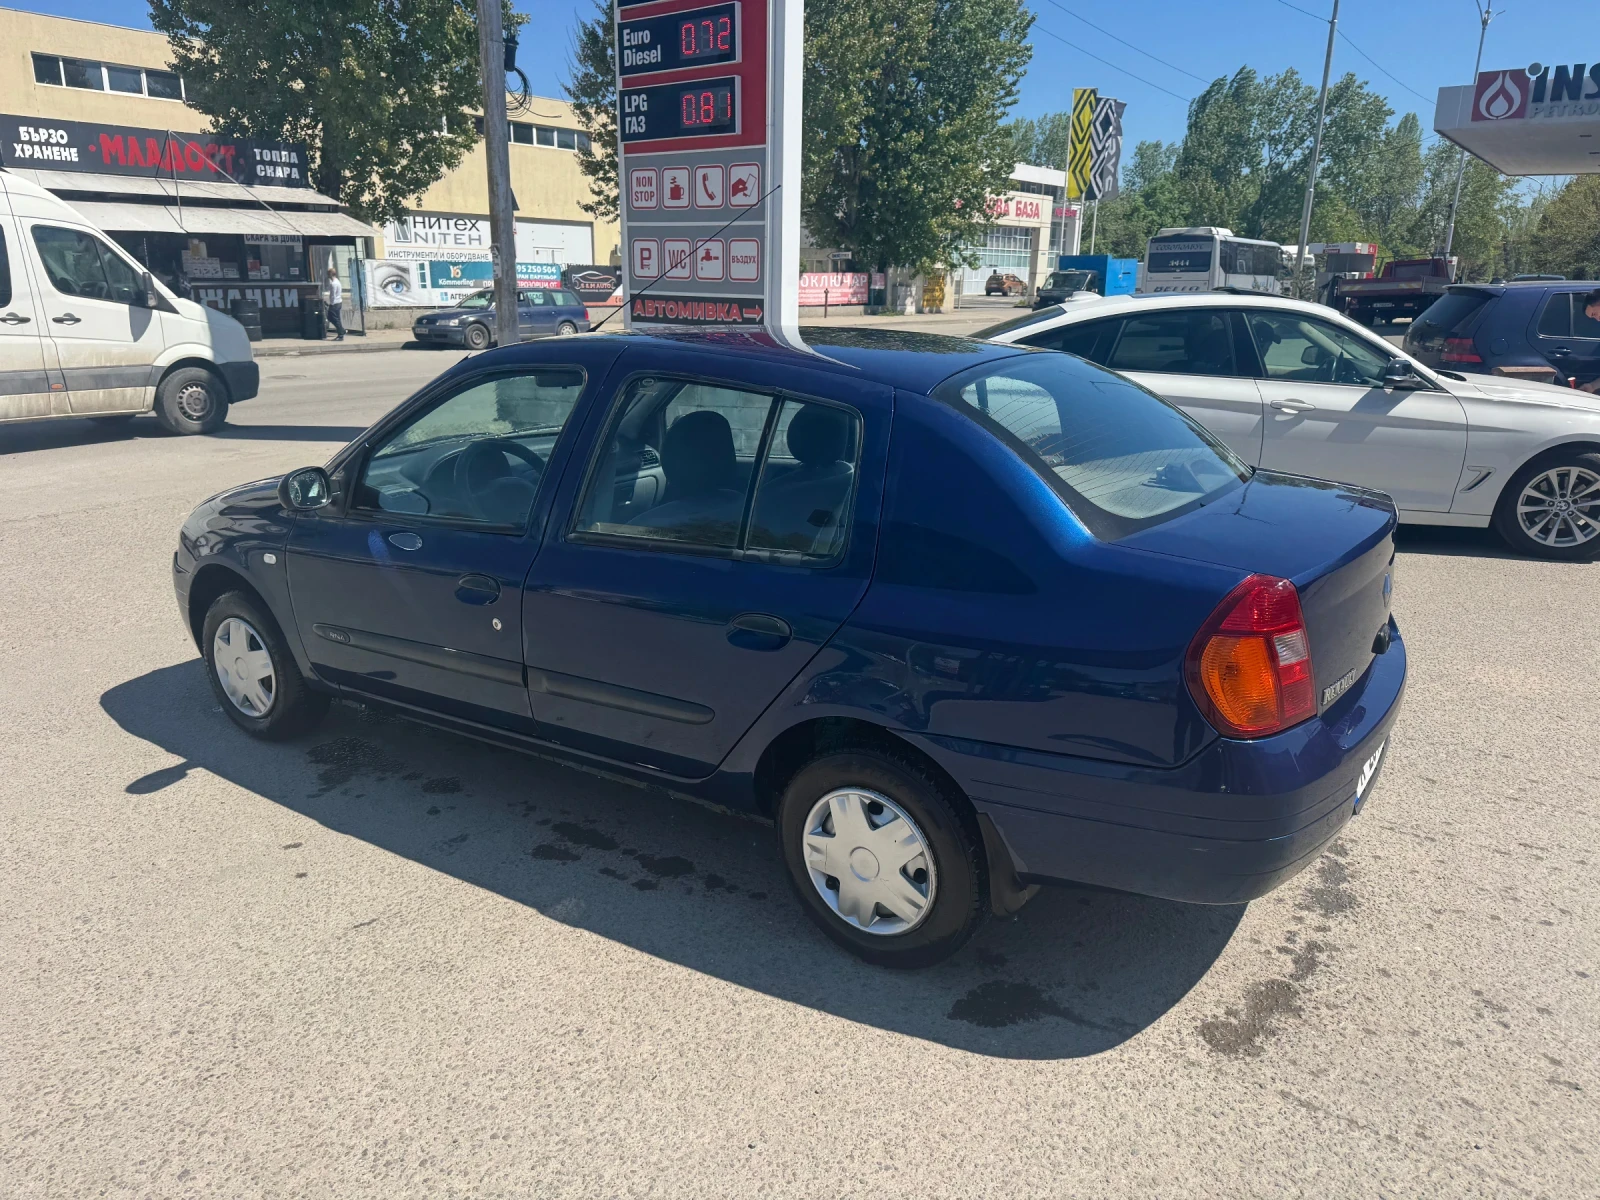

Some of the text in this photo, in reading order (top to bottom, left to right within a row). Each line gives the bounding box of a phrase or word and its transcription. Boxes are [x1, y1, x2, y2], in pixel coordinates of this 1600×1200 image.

[623, 29, 650, 47] Euro
[681, 17, 731, 56] 0.72
[624, 45, 661, 67] Diesel
[624, 94, 648, 113] LPG
[1529, 103, 1600, 119] PETRO
[625, 116, 646, 134] ГАЗ
[19, 126, 68, 144] БЪРЗО
[13, 143, 79, 162] ХРАНЕНЕ
[99, 133, 236, 174] МЛАДОСТ
[256, 164, 300, 179] СКАРА
[636, 176, 653, 188] NON
[634, 191, 655, 202] STOP
[1015, 200, 1040, 219] БАЗА
[245, 234, 268, 242] СКАРА
[280, 234, 301, 245] ДОМА
[413, 231, 482, 246] NITEH
[388, 250, 438, 259] ИНСТРУМЕНТИ
[446, 252, 489, 261] ОБОРУДВАНЕ
[668, 249, 687, 269] WC
[731, 255, 757, 265] ВЪЗДУХ
[633, 299, 743, 322] АВТОМИВКА
